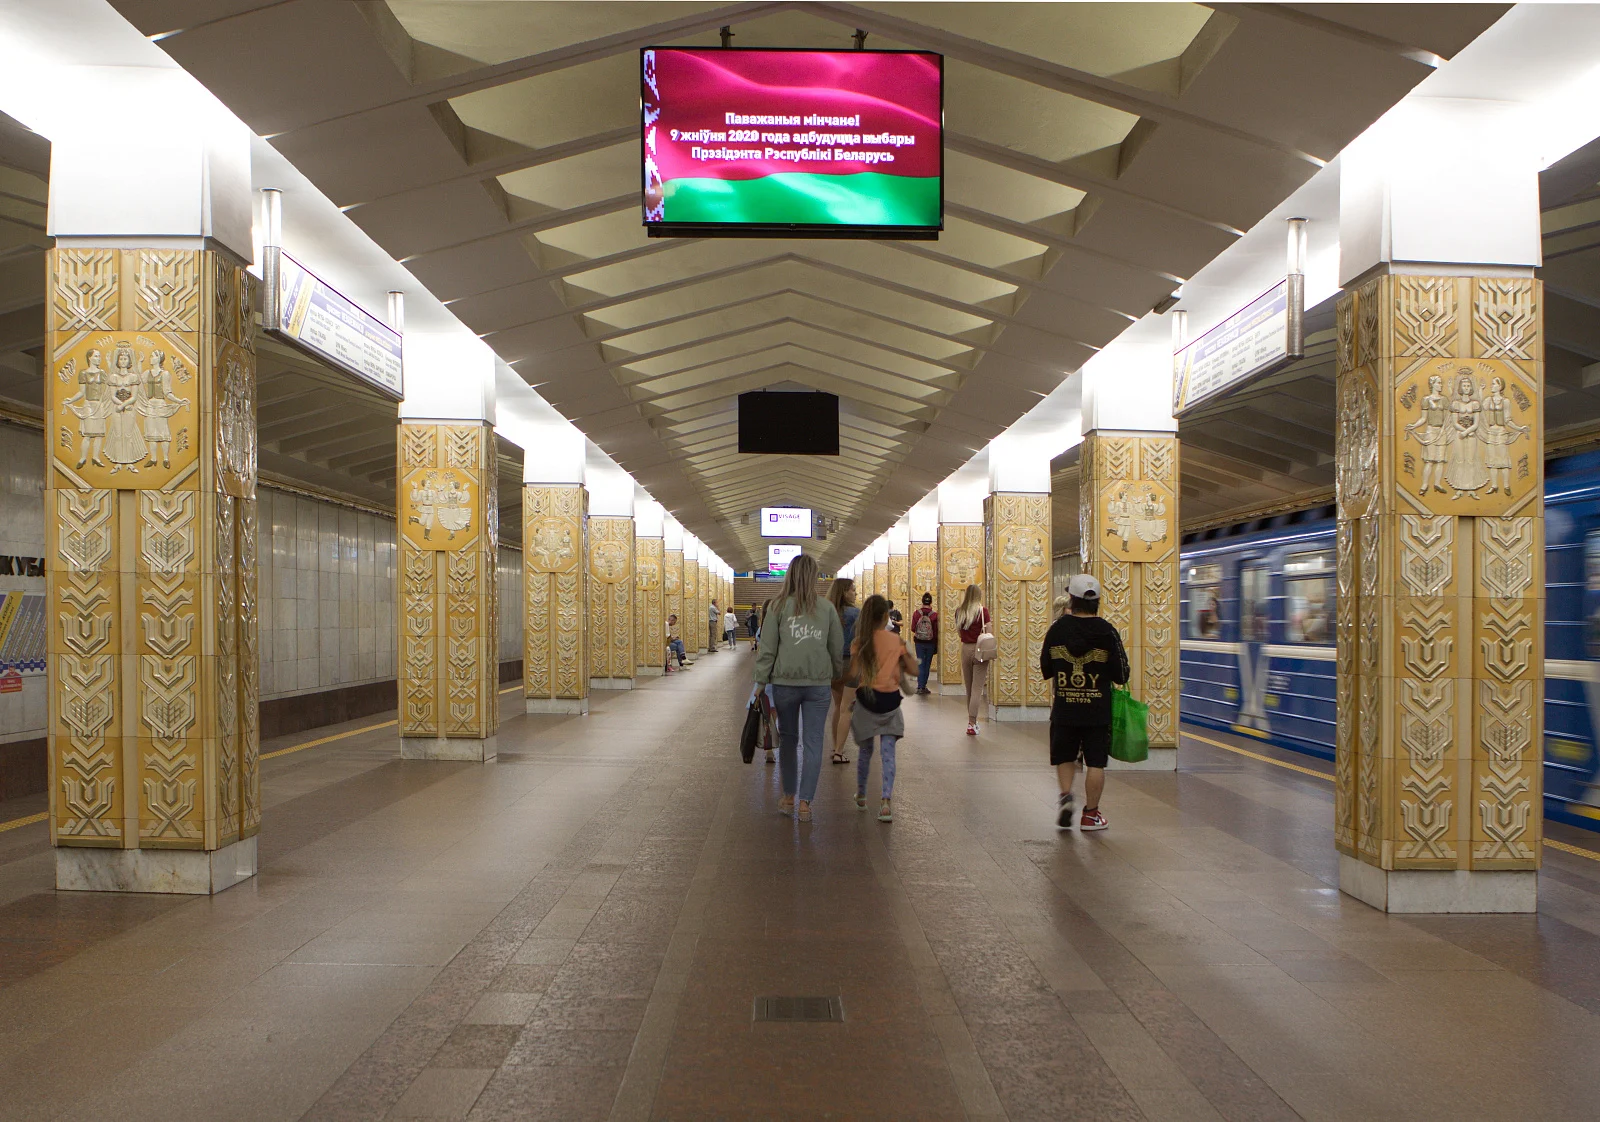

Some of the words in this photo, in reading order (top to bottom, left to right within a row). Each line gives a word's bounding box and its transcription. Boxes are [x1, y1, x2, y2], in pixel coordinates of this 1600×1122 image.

[725, 112, 801, 126] Паважаныя
[803, 114, 861, 127] мінчане!
[670, 129, 678, 141] 9
[680, 129, 726, 143] жніўня
[728, 130, 760, 142] 2020
[761, 132, 790, 145] года
[792, 131, 861, 146] адбудуцца
[862, 133, 915, 147] выбары
[691, 147, 762, 161] Прэзідэнта
[764, 147, 832, 162] Рэспублікі
[834, 149, 895, 164] Беларусь
[787, 615, 822, 642] Fashion
[1058, 671, 1099, 688] BOY
